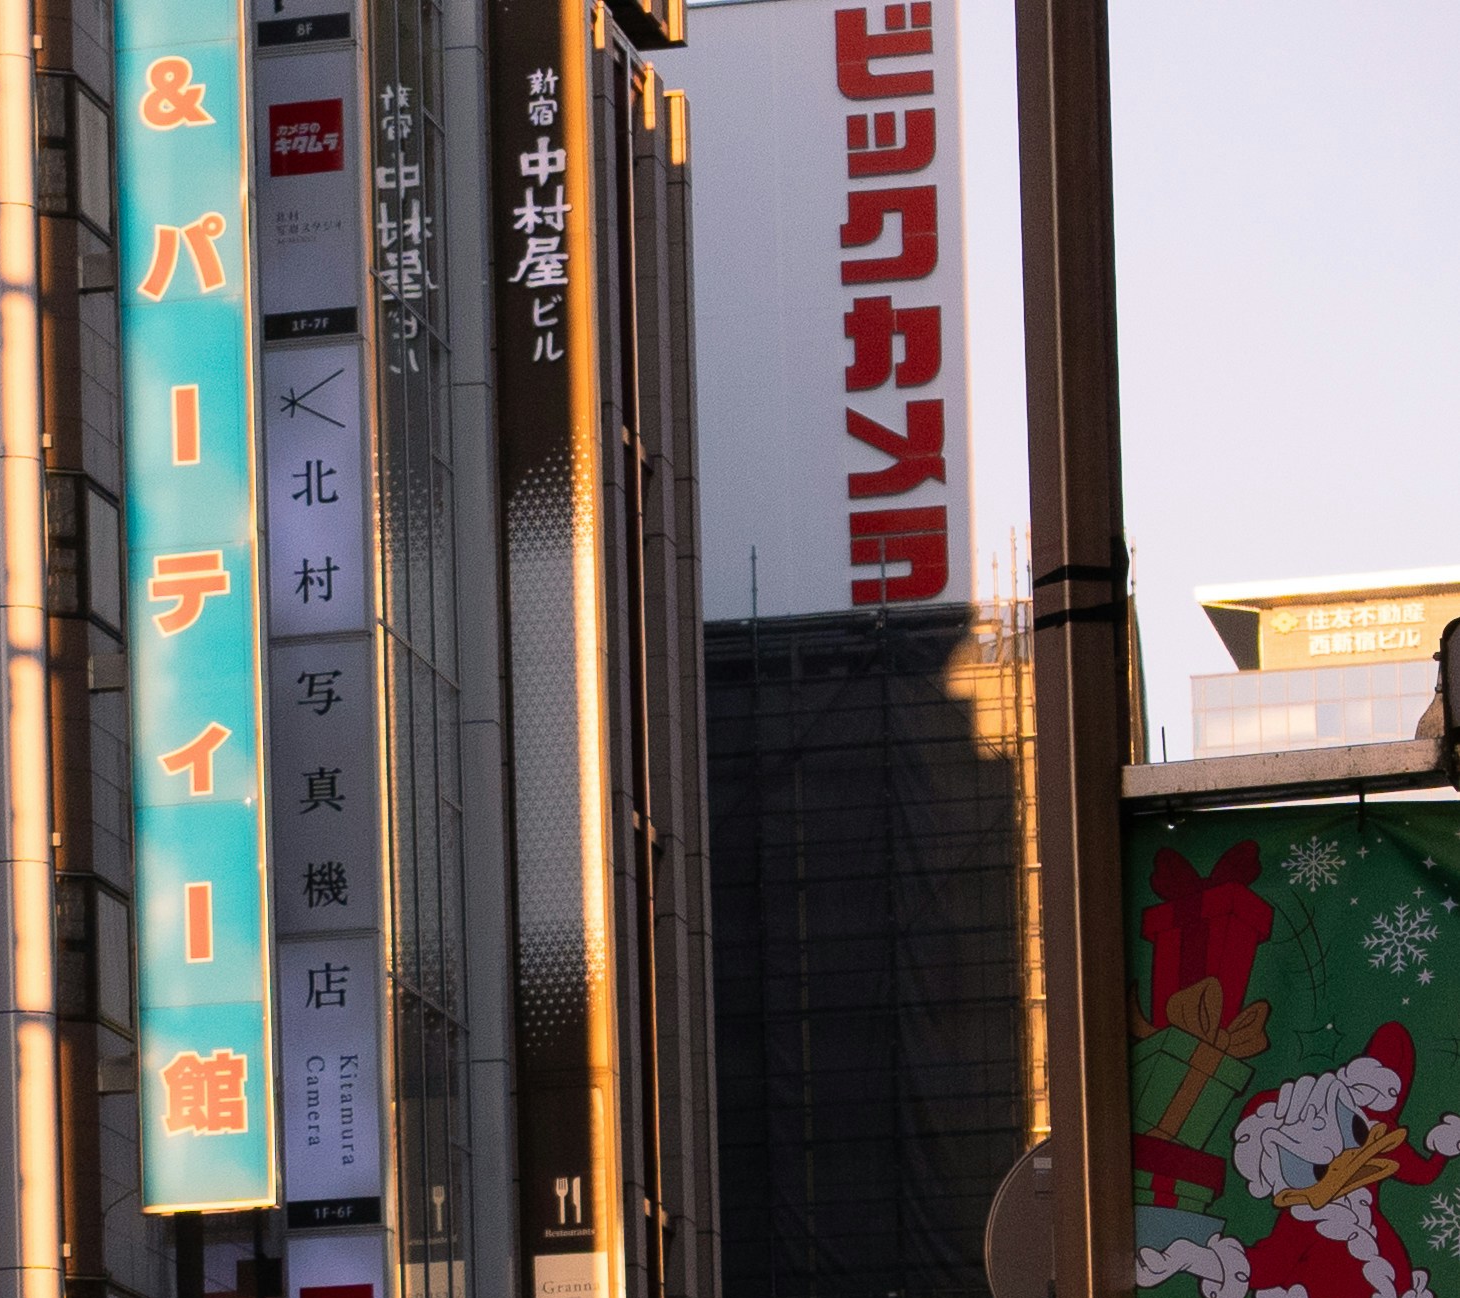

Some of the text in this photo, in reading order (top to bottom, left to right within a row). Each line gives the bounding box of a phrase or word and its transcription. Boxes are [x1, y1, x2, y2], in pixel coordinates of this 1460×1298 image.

[274, 133, 339, 155] キタムラ
[833, 0, 949, 604] ビックカメラ
[1306, 603, 1426, 631] 住友不動産
[1308, 628, 1422, 657] 西新宿ビル
[290, 459, 352, 1010] 北村写真機店
[304, 1055, 325, 1148] Camera
[338, 1053, 359, 1168] Kitamura
